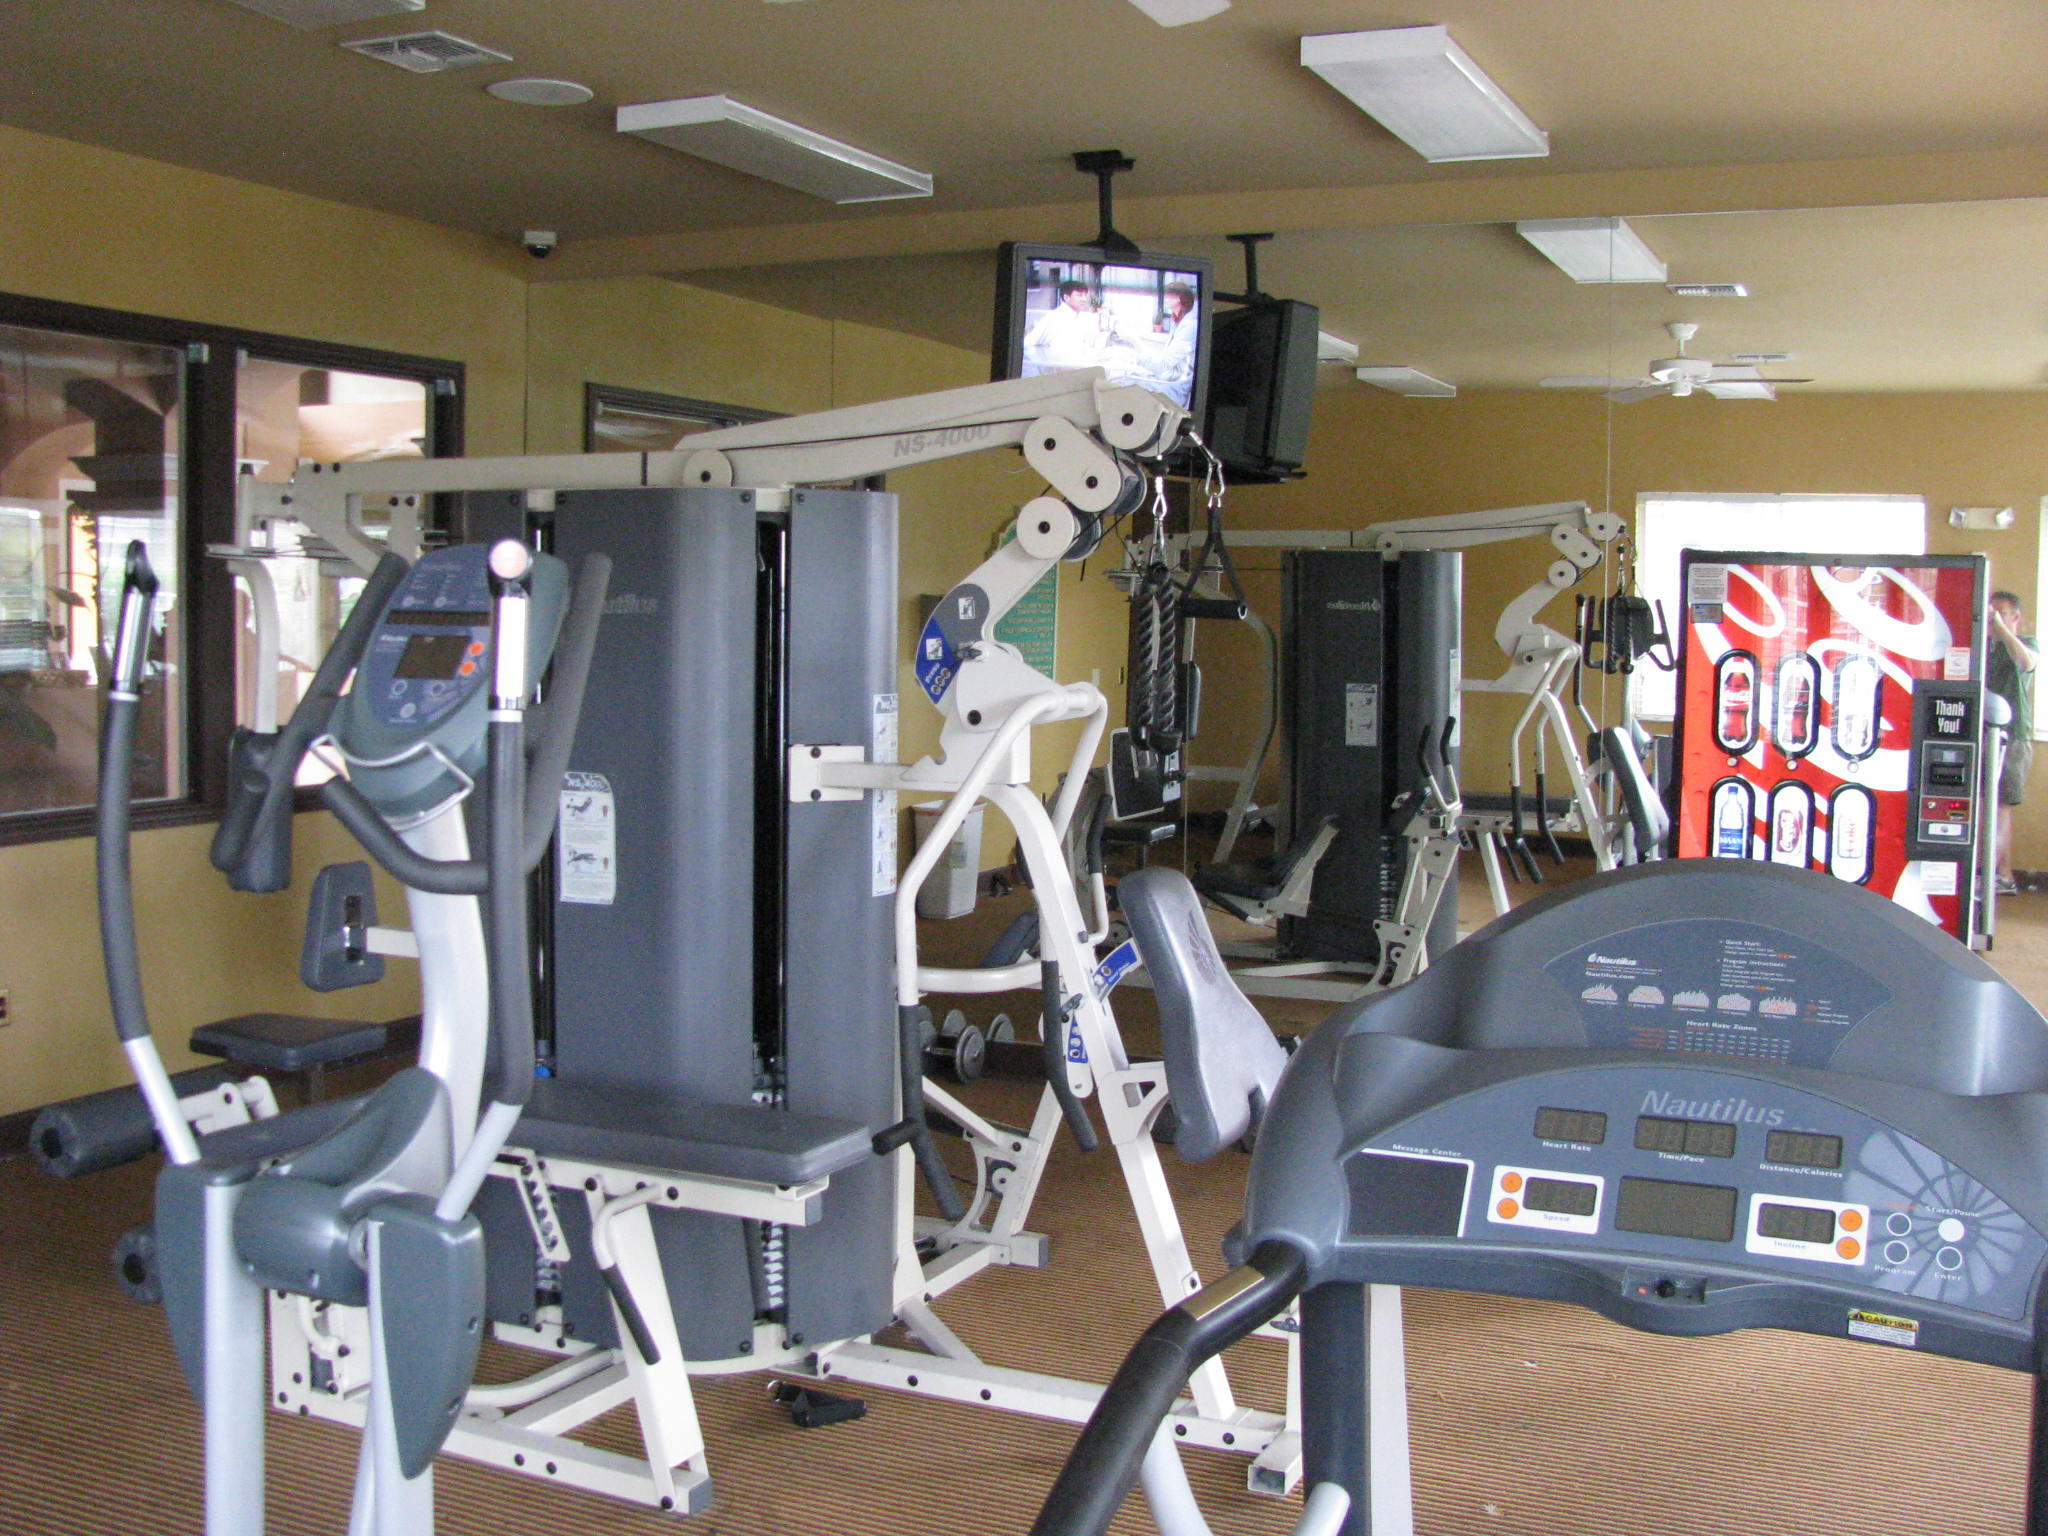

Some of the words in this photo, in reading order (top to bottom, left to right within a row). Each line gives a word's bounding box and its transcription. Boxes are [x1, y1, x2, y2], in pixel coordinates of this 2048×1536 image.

[894, 425, 990, 458] NS-4000
[1935, 700, 1965, 717] Thank
[1938, 717, 1960, 734] You!
[1596, 956, 1637, 966] Nautilus
[1686, 1020, 1709, 1028] Heart
[1640, 1090, 1785, 1127] Nautilus
[1393, 1143, 1429, 1155] Message
[1432, 1147, 1462, 1157] Center
[1542, 1141, 1568, 1150] Heart
[1571, 1143, 1592, 1152] Rate
[1658, 1152, 1705, 1163] Time/Pace
[1759, 1163, 1843, 1178] Distance/Calories
[1874, 1264, 1917, 1276] Program
[1934, 1272, 1963, 1281] Enter
